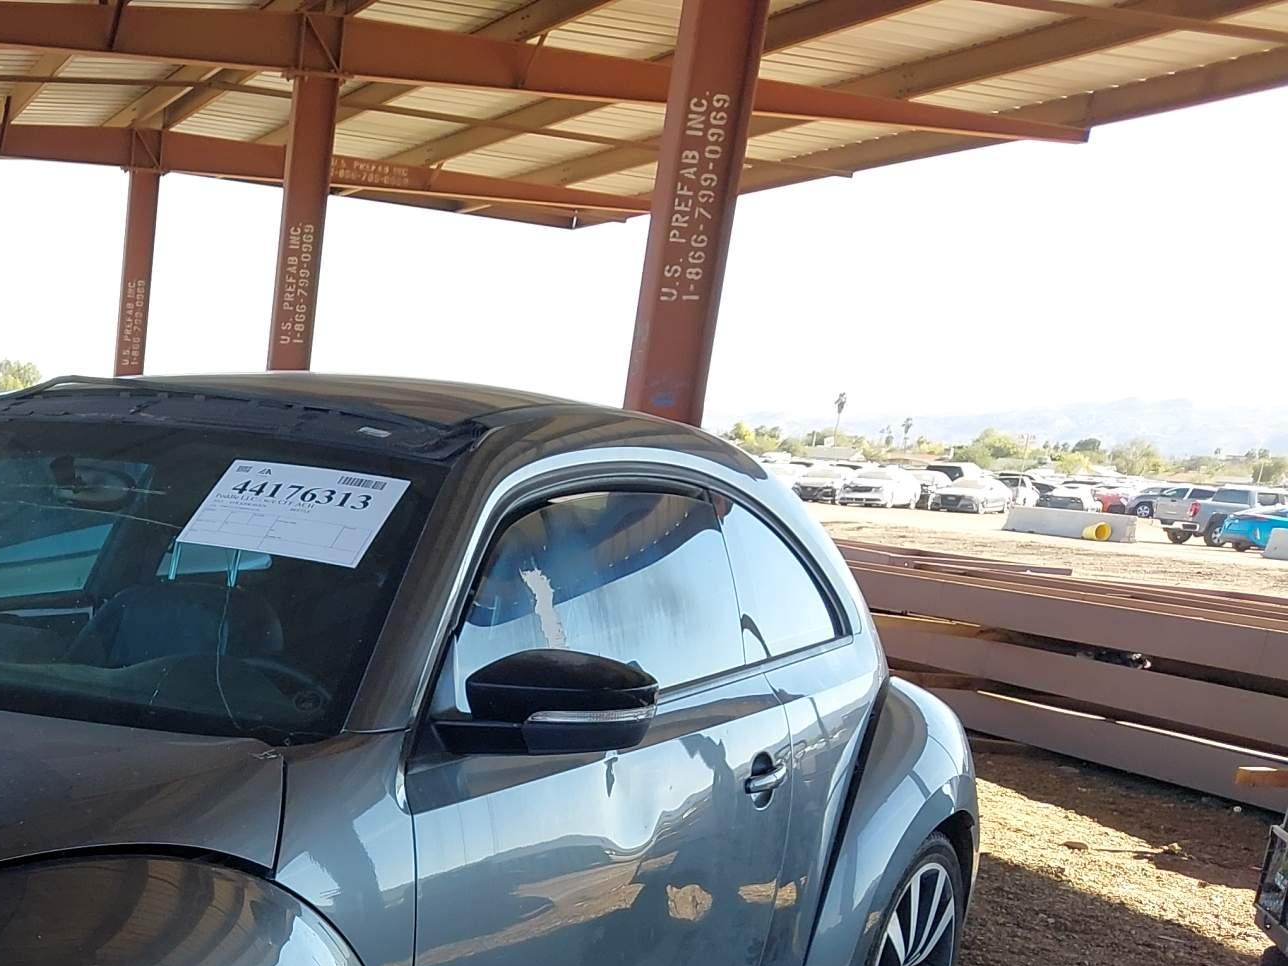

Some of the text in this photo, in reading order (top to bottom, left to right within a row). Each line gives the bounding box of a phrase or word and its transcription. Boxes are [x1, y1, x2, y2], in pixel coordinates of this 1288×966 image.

[660, 91, 710, 301] U.S. PREFAB INC.
[682, 94, 731, 301] 1-866-799-0969
[280, 222, 302, 344] U.S. PREFAB INC.
[232, 479, 372, 510] 44176313
